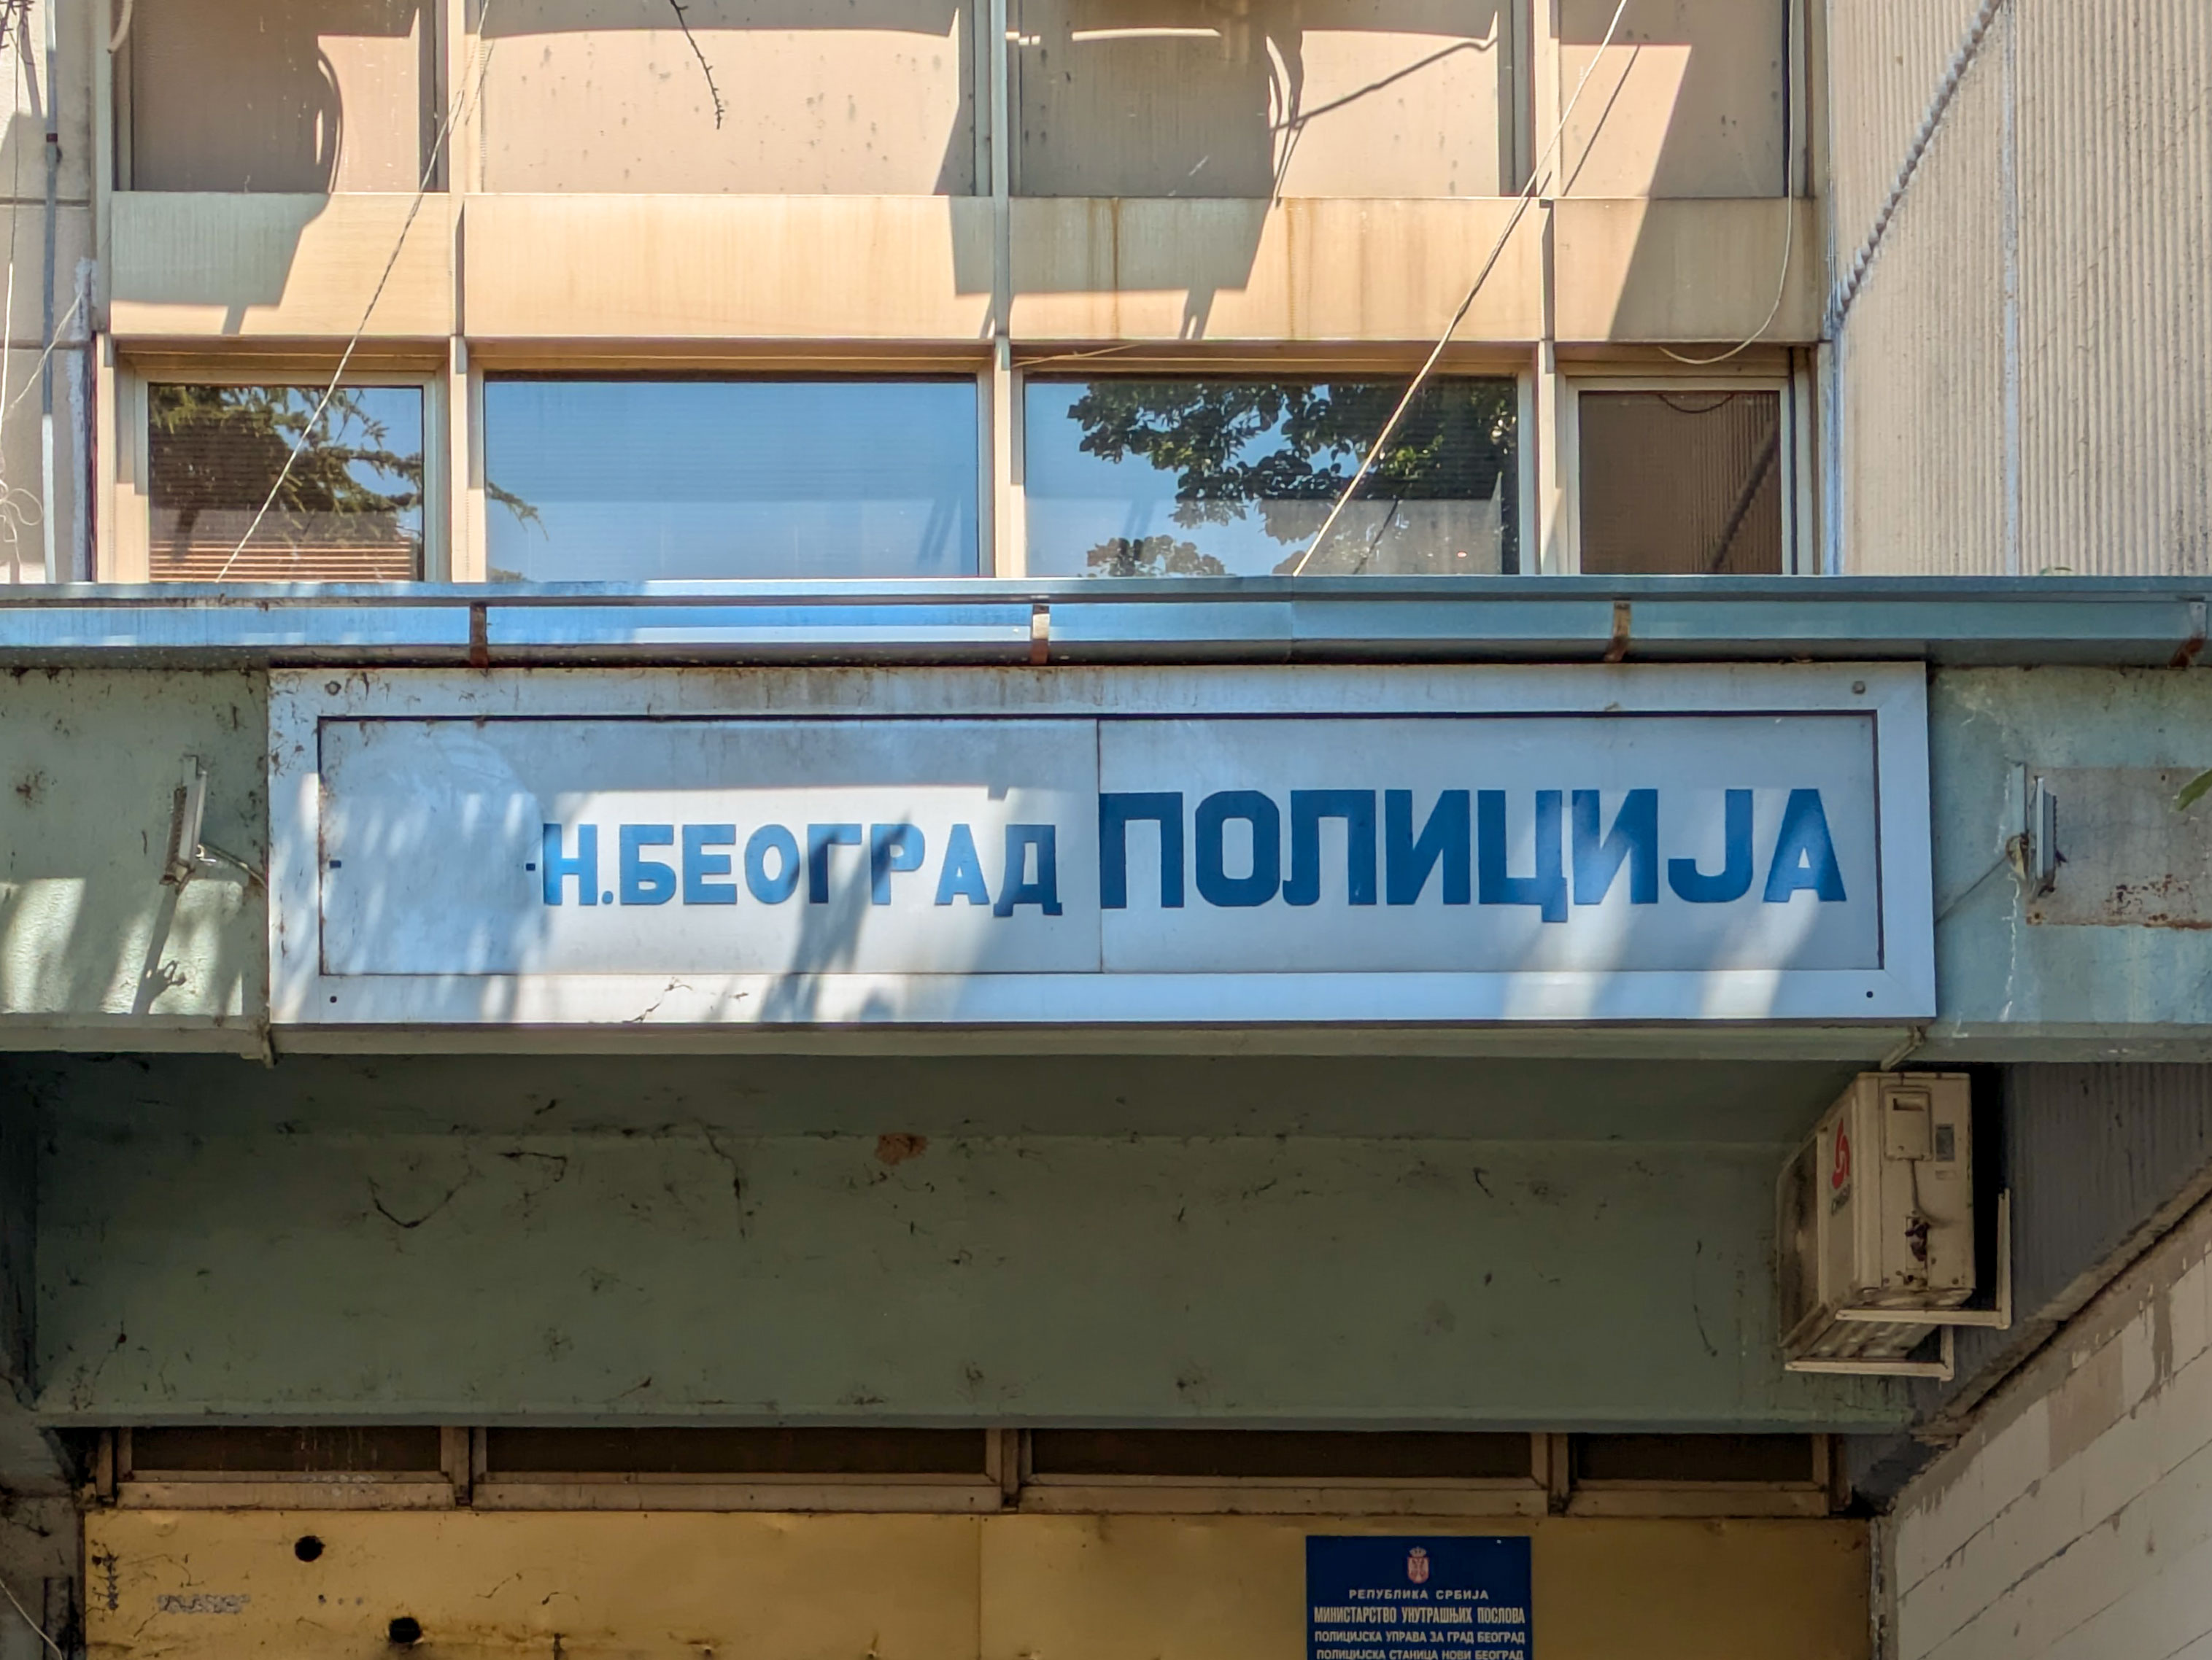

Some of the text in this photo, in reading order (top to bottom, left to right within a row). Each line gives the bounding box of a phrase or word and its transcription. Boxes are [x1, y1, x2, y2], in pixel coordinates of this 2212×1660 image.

[543, 789, 1846, 923] Н.БЕОГРАД ПОЛИЦИЈА
[1349, 1589, 1489, 1599] РЕПУБЛИКА СРБИЈА
[1314, 1607, 1525, 1624] МИНИСТАРСТВО УНУТРАШЊИХ ПОСЛОВА
[1315, 1631, 1525, 1645] ПОЛИЦИЈСКА УПРАВА ЗА ГРАД БЕОГРАД
[1316, 1649, 1524, 1660] ПОЛИЦИЈСКА СТАНИЦА НОВИ БЕОГРАД
